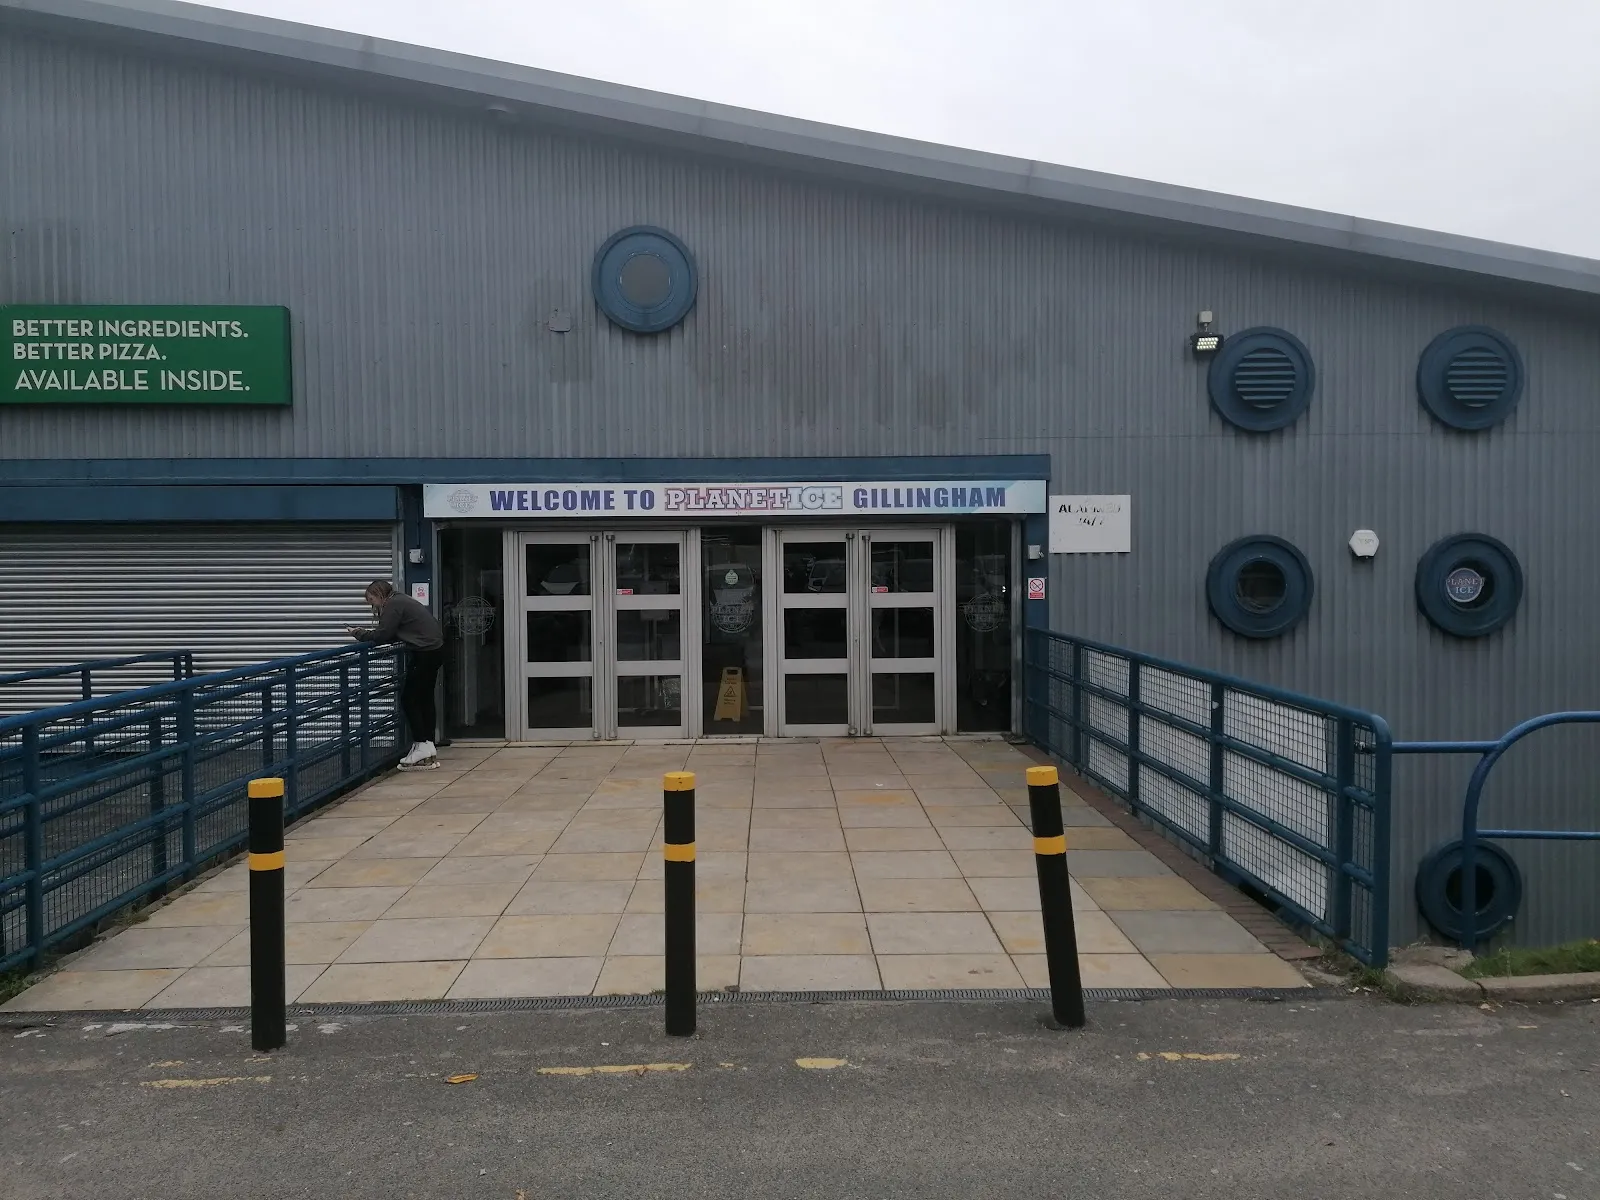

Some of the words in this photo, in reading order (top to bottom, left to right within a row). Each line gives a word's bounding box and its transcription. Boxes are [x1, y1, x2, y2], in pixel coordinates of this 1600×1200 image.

[12, 319, 94, 337] BETTER
[98, 320, 249, 338] INGREDIENTS.
[13, 342, 94, 360] BETTER
[99, 343, 167, 361] PIZZA.
[14, 369, 149, 391] AVAILABLE
[160, 370, 251, 391] INSIDE.
[490, 489, 616, 511] WELCOME
[623, 489, 655, 511] TO
[853, 487, 1006, 509] GILLINGHAM
[1455, 586, 1474, 594] ICE
